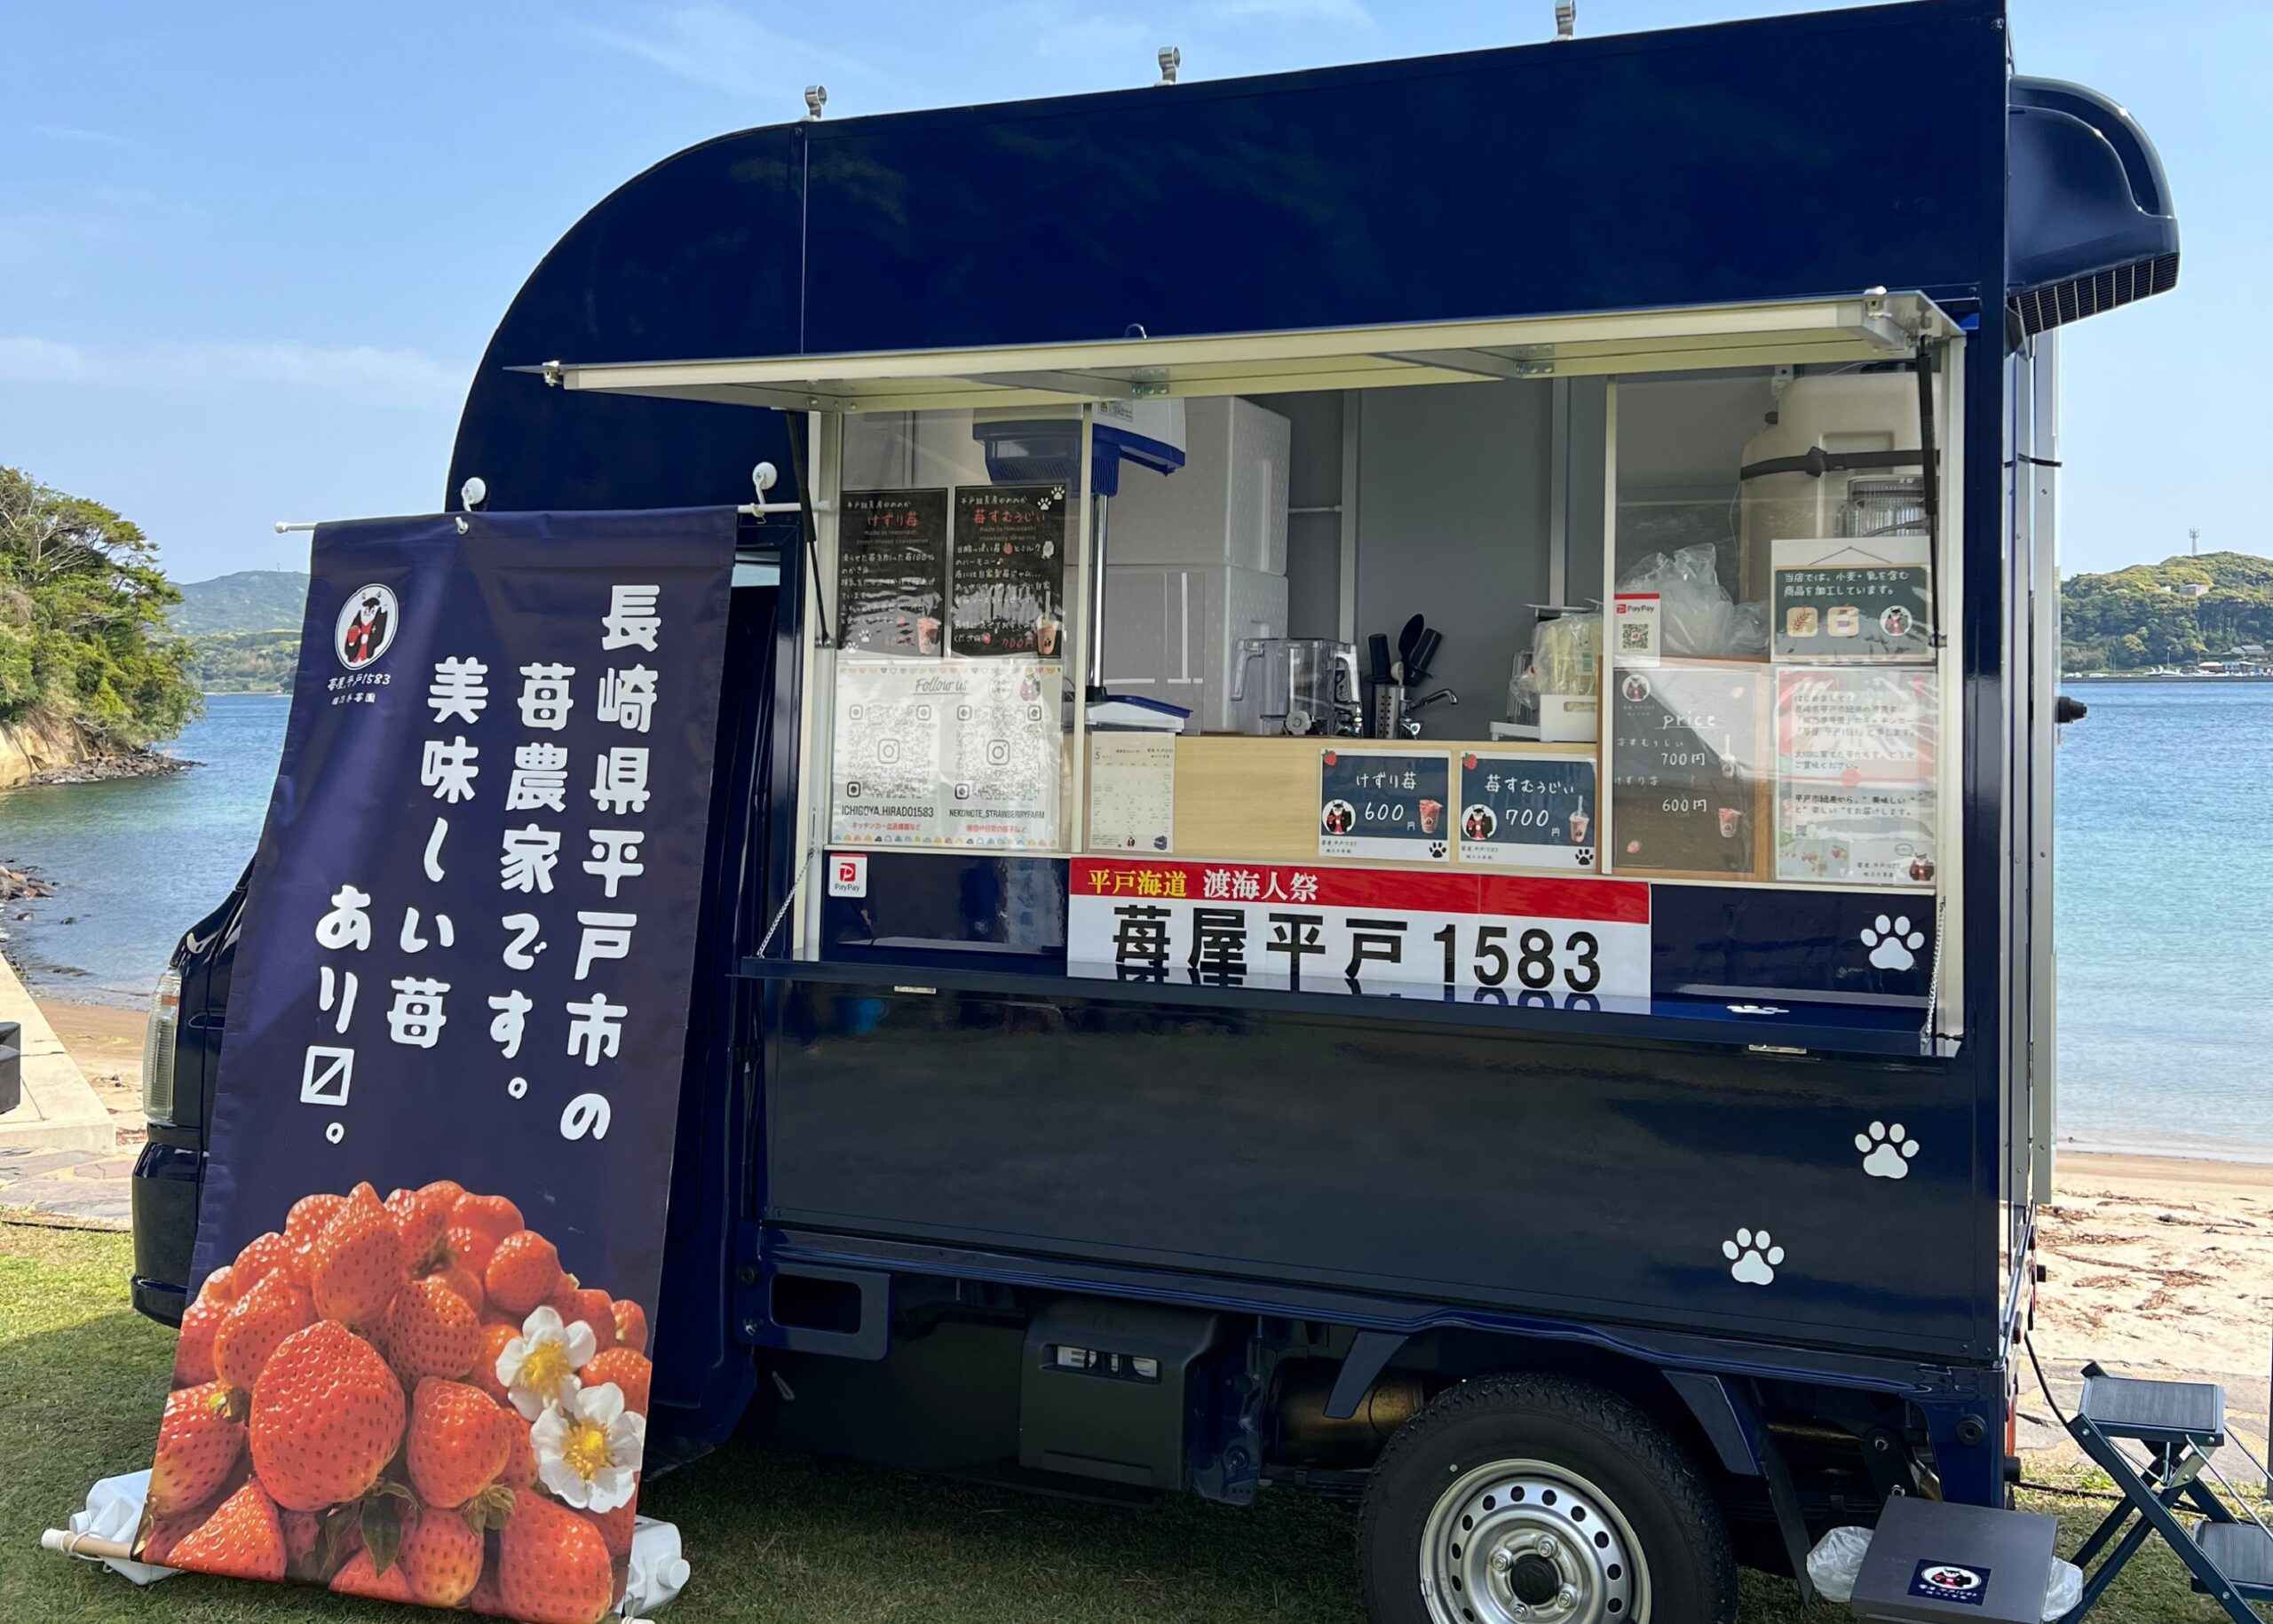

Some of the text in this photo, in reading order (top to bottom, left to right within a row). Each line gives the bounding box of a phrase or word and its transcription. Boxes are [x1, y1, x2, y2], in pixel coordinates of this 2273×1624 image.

[867, 511, 917, 527] けずり苺
[973, 507, 1045, 524] 苺すむうじい
[915, 677, 954, 692] Follow
[1663, 710, 1716, 730] price
[1356, 772, 1416, 790] けずり苺
[1484, 773, 1574, 795] 苺すむうじい
[1364, 802, 1404, 821] 600
[1505, 809, 1549, 827] 700
[386, 656, 488, 1049] 美味しい苺
[559, 584, 661, 1141] 長崎県平戸市の
[487, 661, 576, 1099] 苺農家です。
[835, 883, 859, 892] PayPay
[1087, 868, 1319, 901] 平戸海道 渡海人祭
[1112, 904, 1601, 994] 苺屋平戸1583
